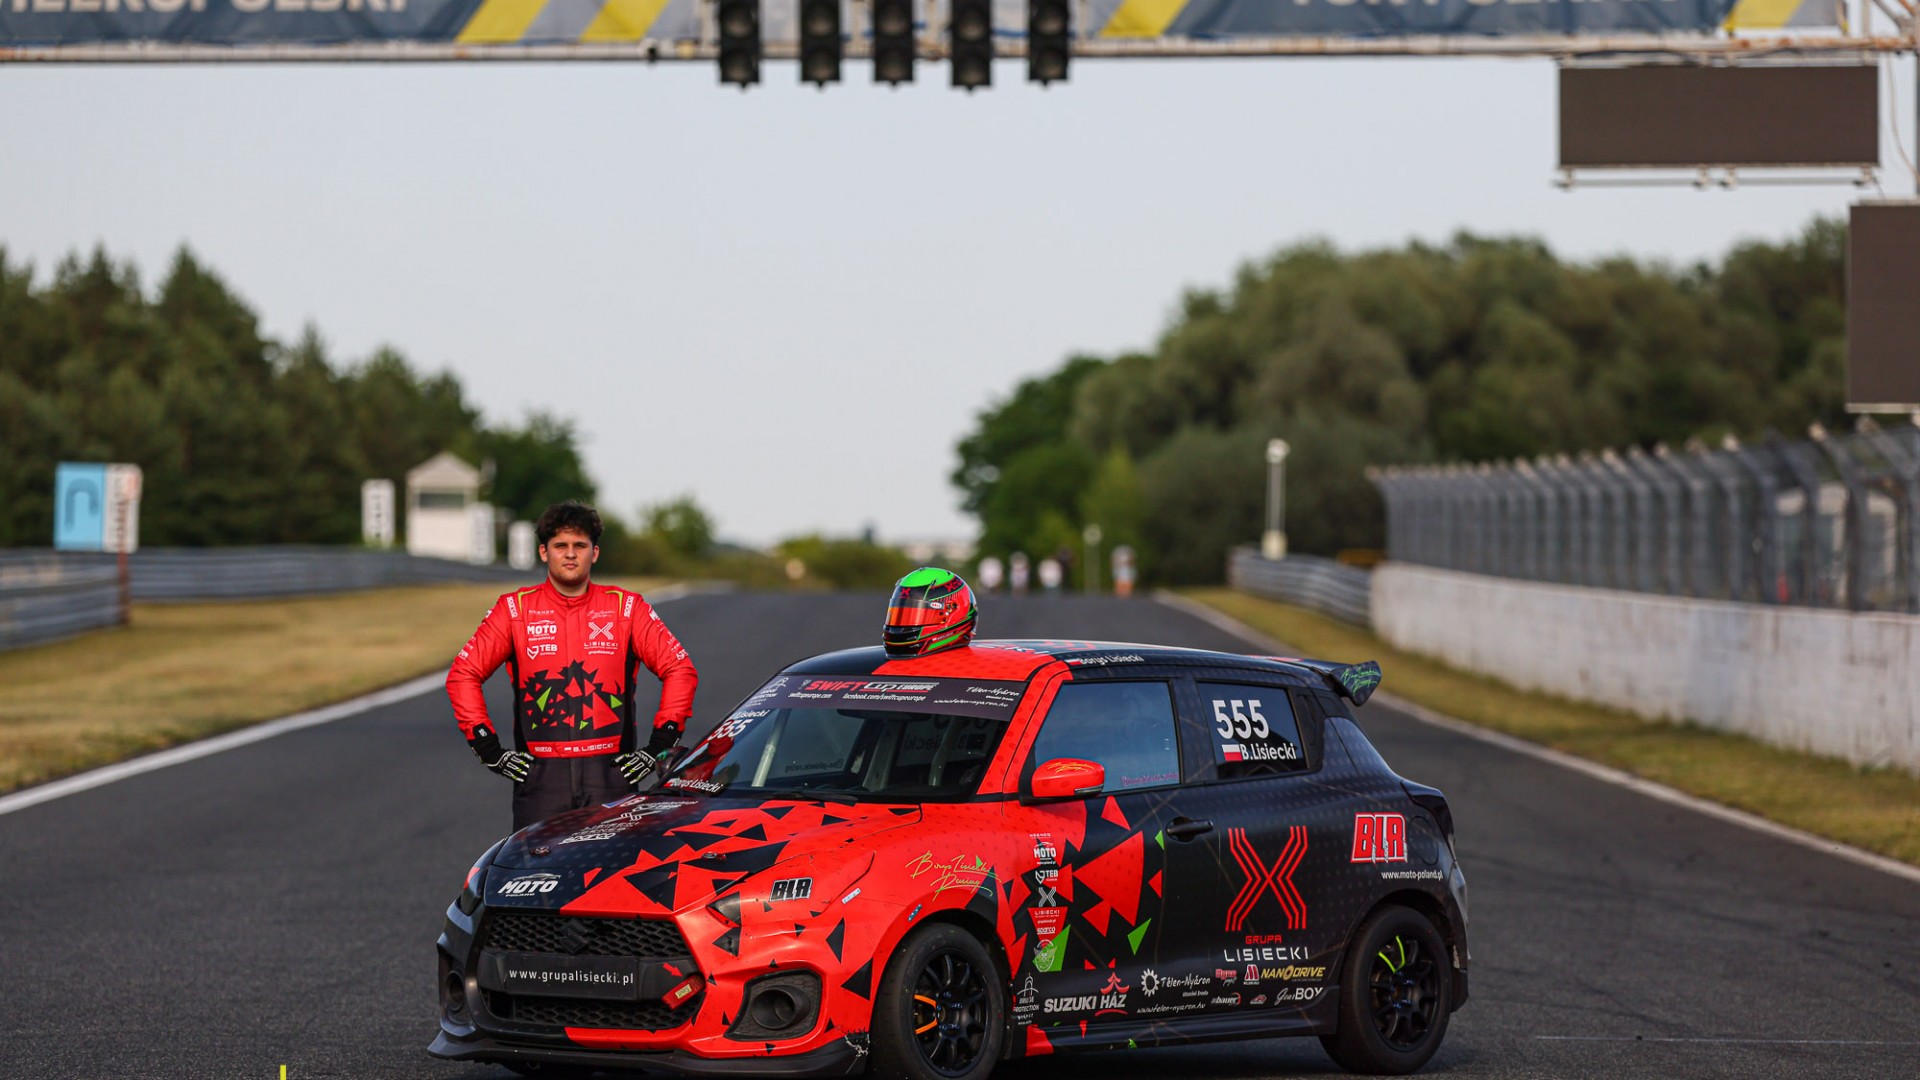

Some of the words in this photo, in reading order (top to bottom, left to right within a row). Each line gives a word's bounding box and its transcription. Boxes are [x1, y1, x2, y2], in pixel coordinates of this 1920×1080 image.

[527, 625, 557, 635] MOTO
[540, 644, 558, 652] TEB
[805, 680, 869, 691] SWIFT
[1212, 700, 1269, 739] 555
[1242, 742, 1297, 761] B.Lisiecki
[690, 779, 723, 792] Lisiecki
[1034, 848, 1056, 858] MOTO
[1046, 869, 1059, 878] TEB
[1381, 870, 1443, 881] www.moto-poland.pl
[497, 880, 558, 894] MOTO
[1245, 935, 1282, 944] GRUPA
[1224, 947, 1308, 962] LISIECKI
[509, 970, 635, 986] www.grupalisiecki.pl
[1261, 965, 1326, 981] NANODRIVE
[1161, 973, 1211, 990] Télen-Nyáron
[1044, 996, 1098, 1013] SUZUKI
[1100, 991, 1128, 1009] HÁZ
